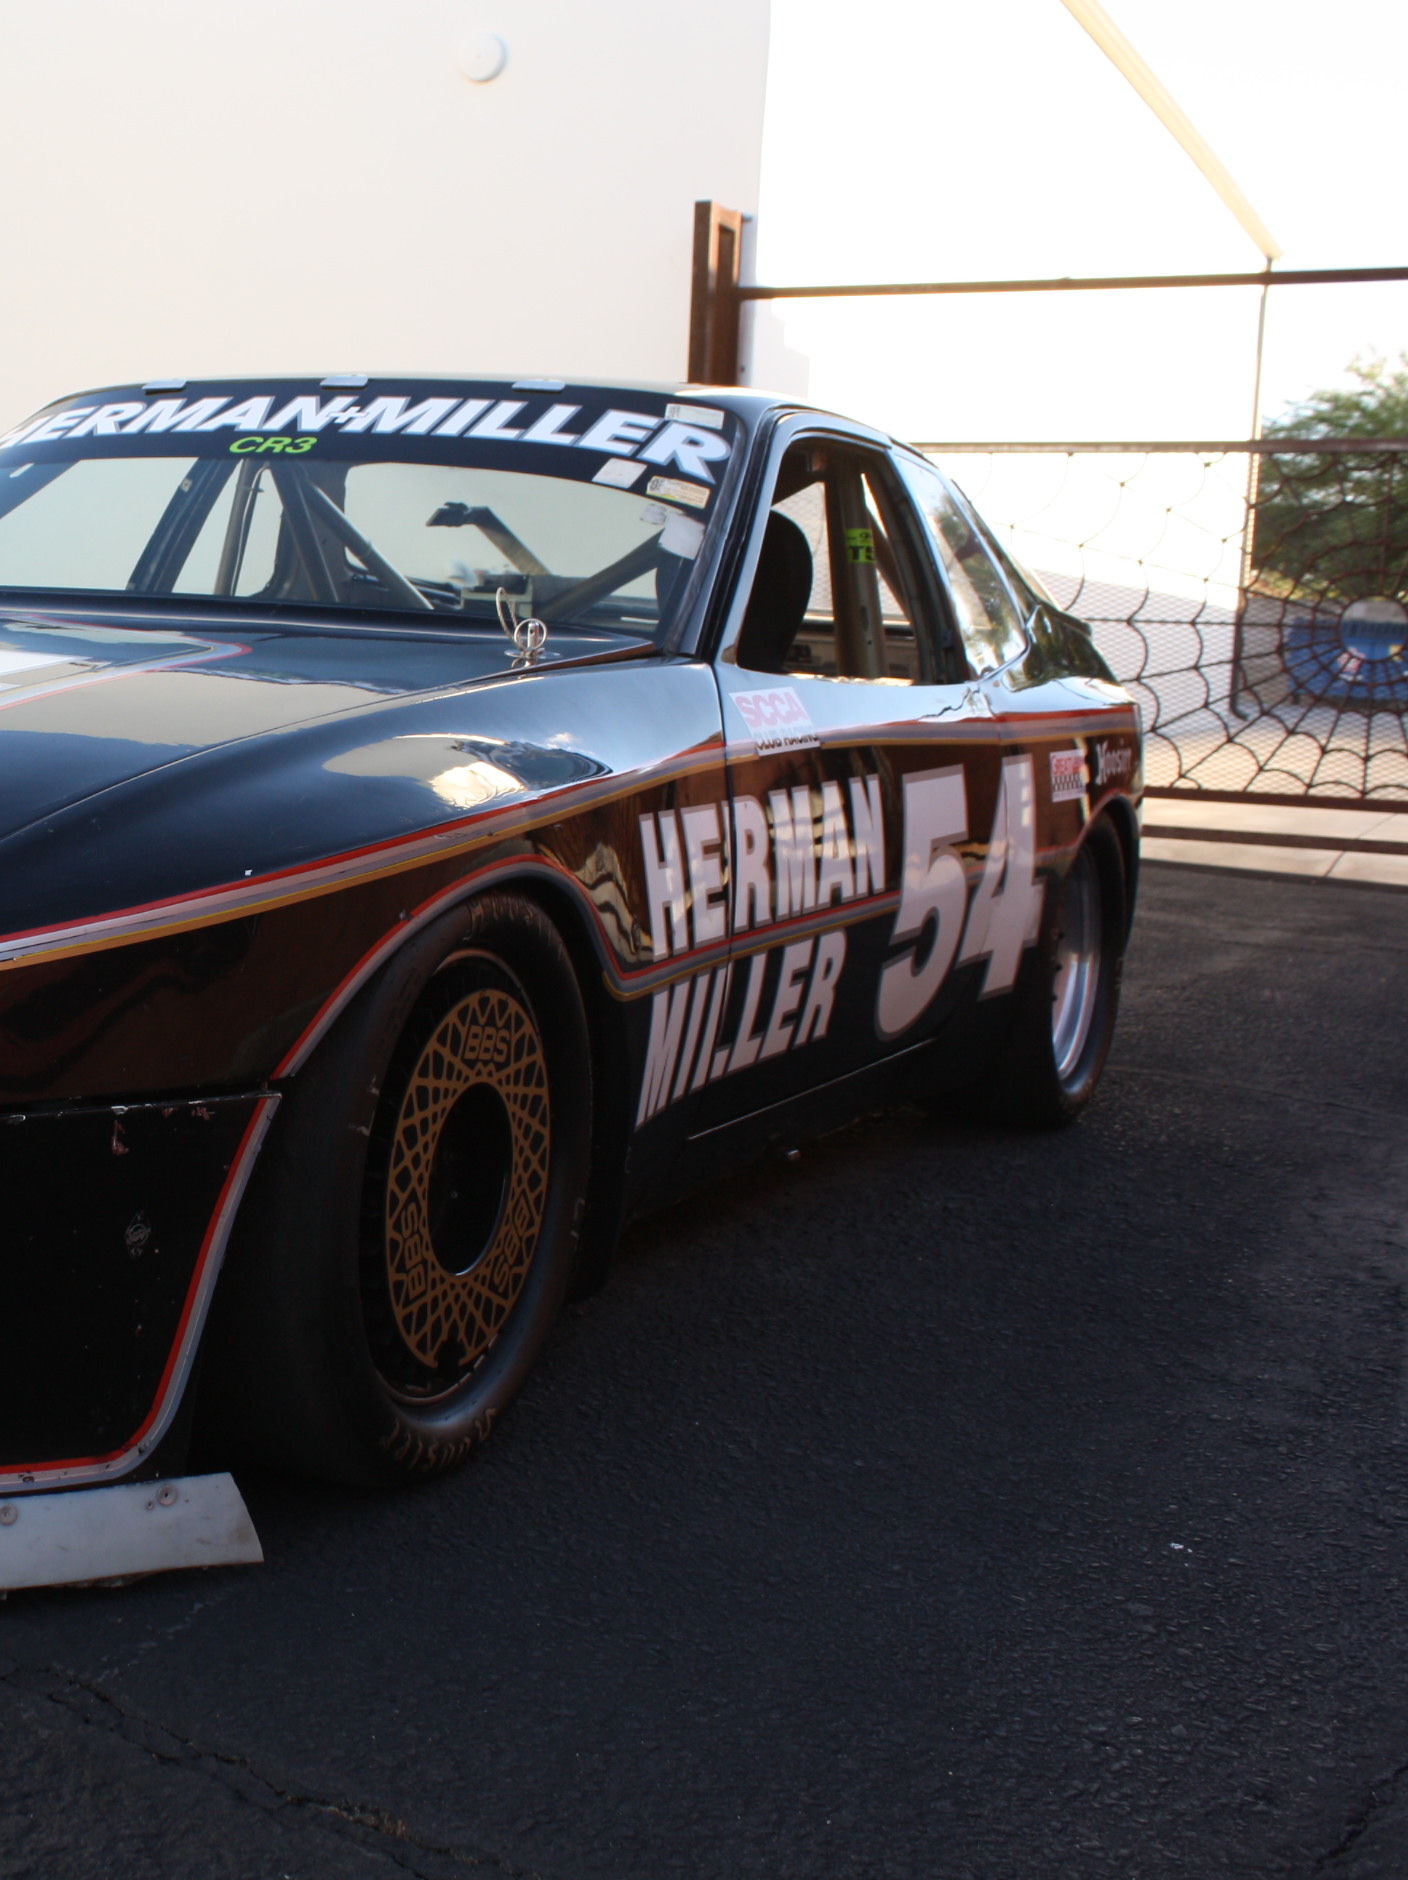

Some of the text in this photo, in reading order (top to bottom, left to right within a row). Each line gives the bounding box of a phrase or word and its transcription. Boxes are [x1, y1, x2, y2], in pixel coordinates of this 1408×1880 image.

[228, 435, 319, 455] CR3
[735, 691, 809, 728] SCCA
[638, 773, 886, 963] HERMAN
[873, 752, 1046, 1043] 54
[464, 1024, 512, 1062] BBS
[634, 928, 848, 1133] MILLER
[400, 1202, 428, 1299] BBS
